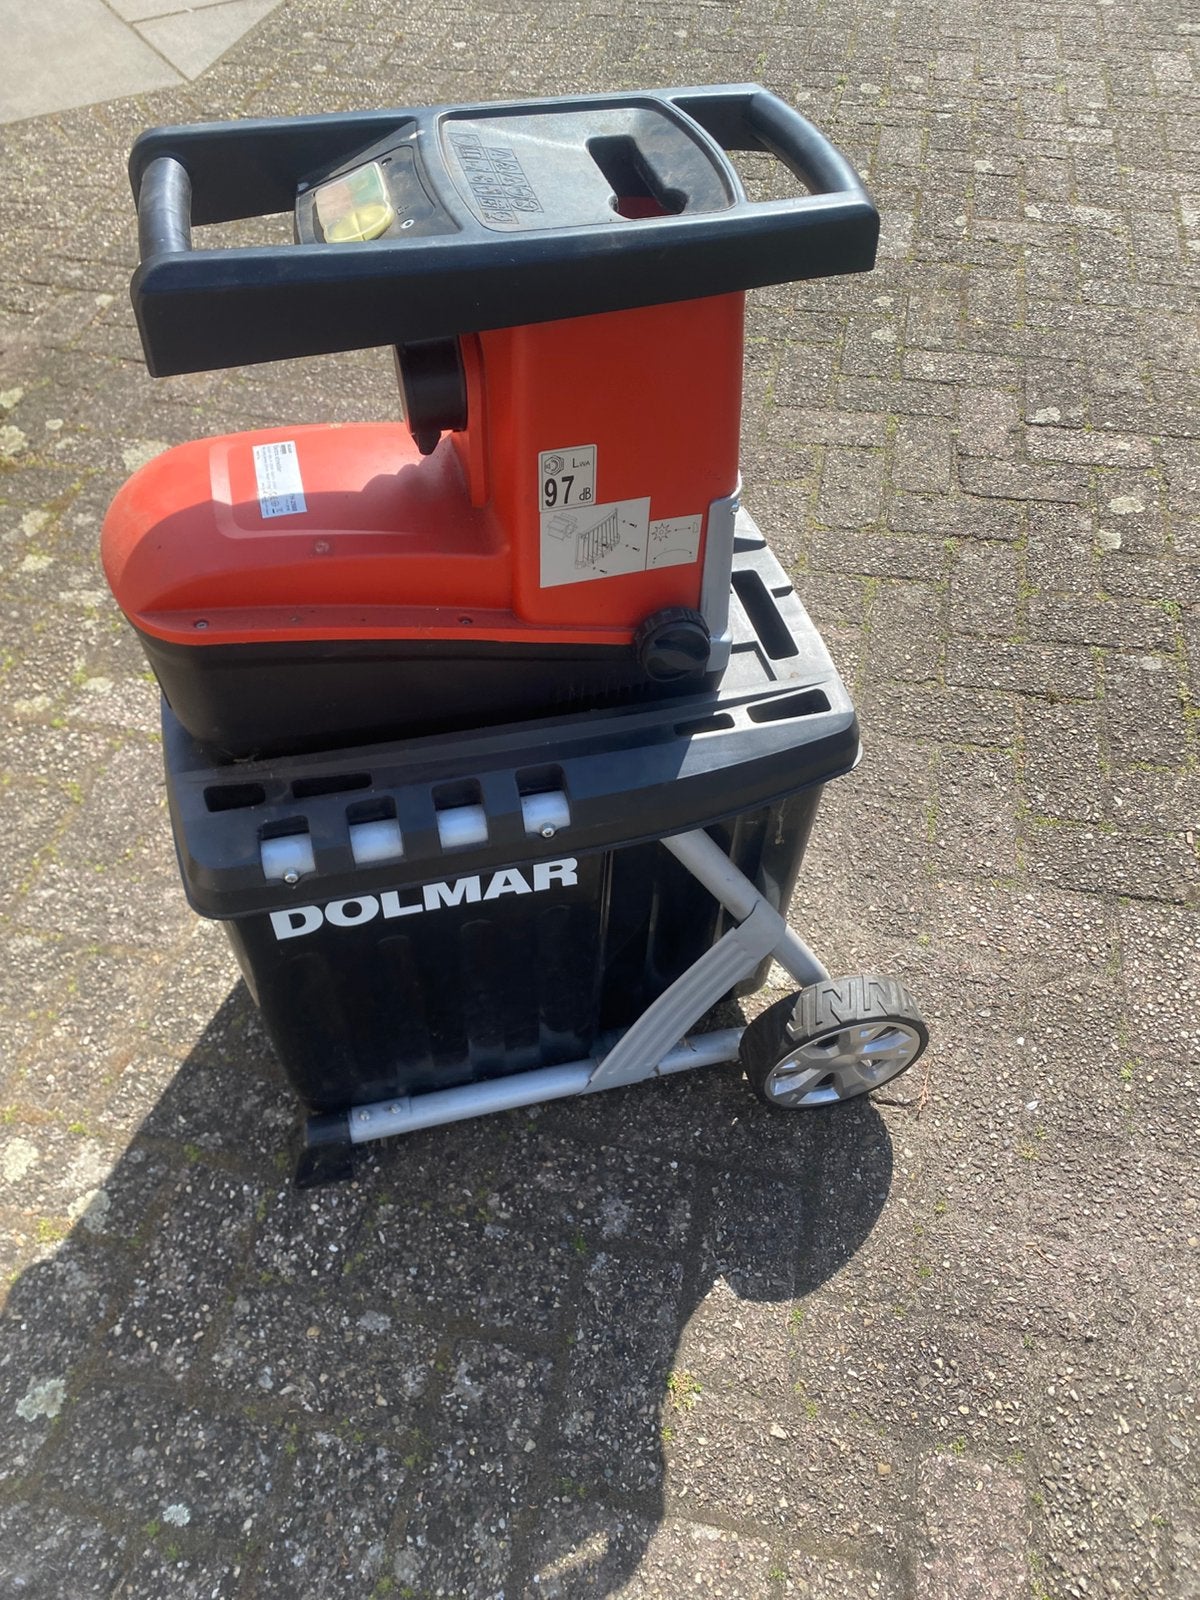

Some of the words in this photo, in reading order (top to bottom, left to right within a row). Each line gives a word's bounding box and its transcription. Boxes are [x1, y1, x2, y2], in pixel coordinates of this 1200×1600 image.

[544, 475, 575, 507] 97
[579, 486, 592, 501] dB
[269, 857, 578, 941] DOLMAR
